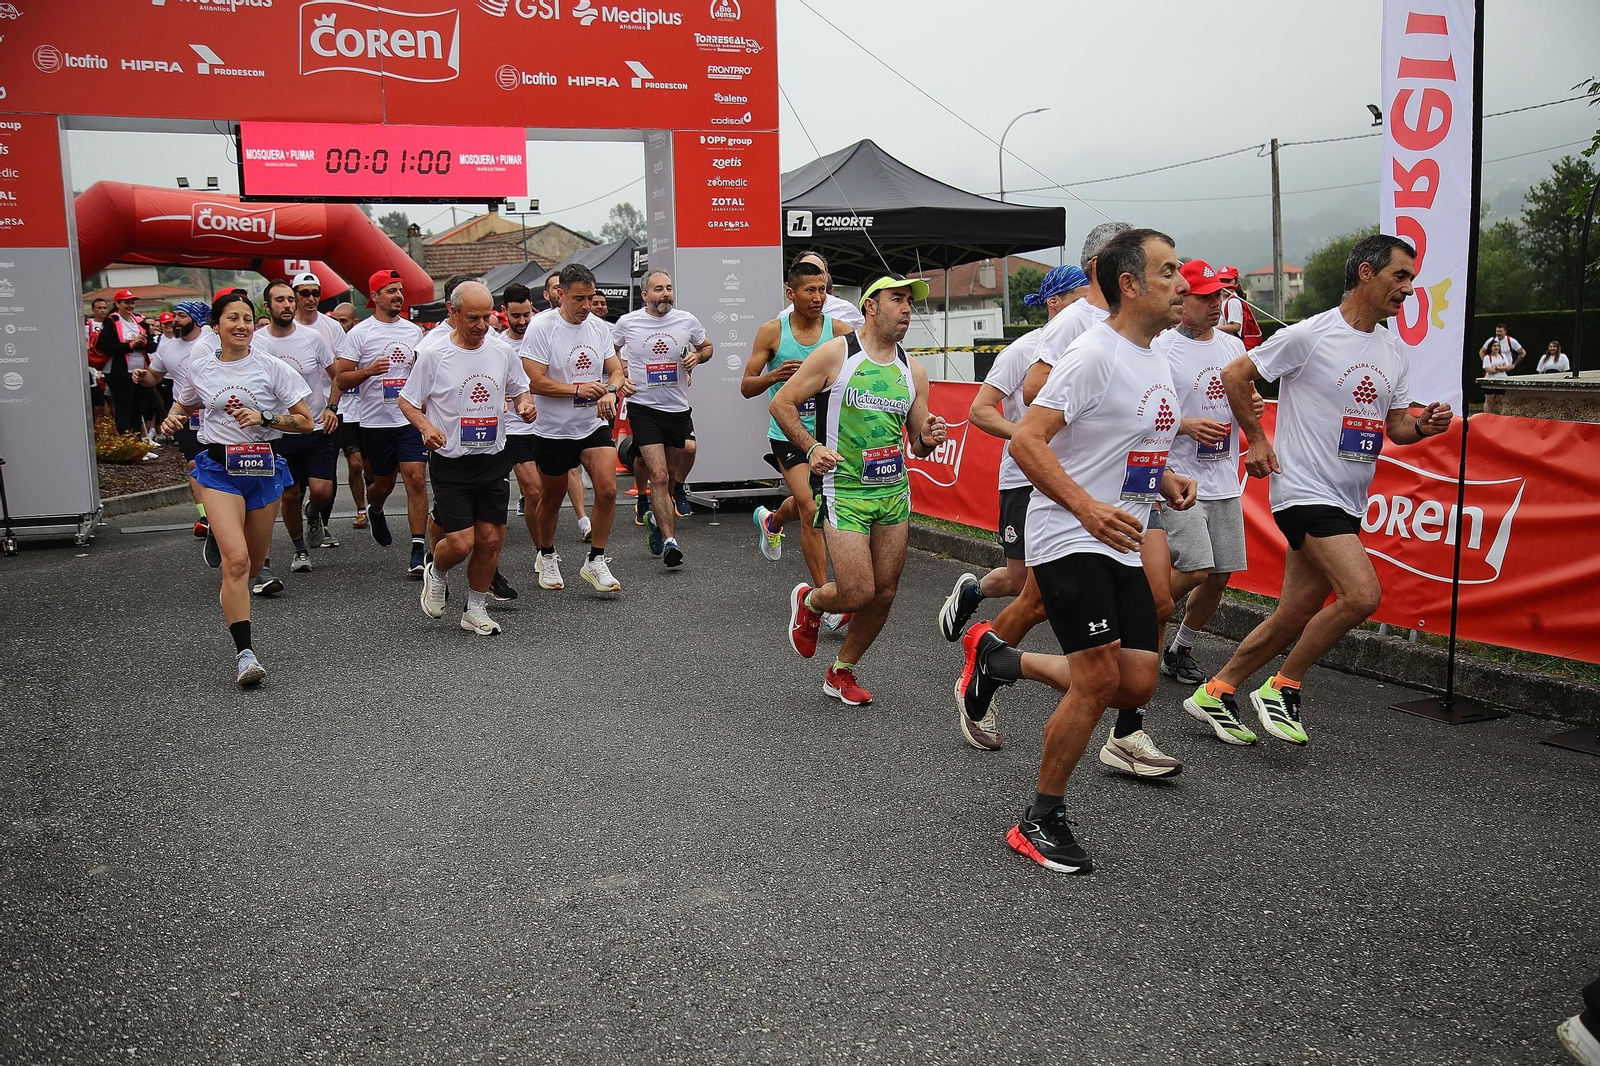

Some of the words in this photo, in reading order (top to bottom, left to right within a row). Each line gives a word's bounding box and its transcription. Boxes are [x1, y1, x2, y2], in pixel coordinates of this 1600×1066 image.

[515, 0, 560, 20] GSI
[714, 10, 737, 18] densa
[602, 7, 682, 30] Mediplus
[65, 53, 108, 69] Icofrio
[121, 59, 183, 73] HIPRA
[214, 68, 265, 77] PRODESCON
[707, 65, 751, 75] FRONTPRO
[522, 72, 558, 86] Icofrio
[568, 76, 620, 88] HIPRA
[645, 82, 688, 90] PRODESCON
[707, 136, 727, 144] OPP
[728, 138, 753, 146] group
[246, 149, 286, 160] MOSQUERA
[290, 150, 315, 160] PUMAR
[459, 154, 496, 165] MOSQUERA
[500, 155, 522, 165] PUMAR
[325, 148, 451, 175] 00:01:00
[712, 157, 742, 169] zoetis
[707, 177, 748, 187] zoomedic
[711, 197, 745, 206] ZOTAL
[816, 217, 874, 227] CCNORTE
[1343, 362, 1369, 378] ANDAINA
[1370, 364, 1392, 394] CAMPEIRA
[1140, 383, 1163, 406] ANDAINA
[804, 402, 815, 410] 12
[475, 431, 487, 440] 17
[1215, 441, 1224, 451] 18
[1359, 440, 1373, 451] 13
[238, 459, 264, 468] 1004
[874, 463, 897, 475] 1003
[1148, 477, 1157, 489] 8
[1361, 494, 1485, 550] oren
